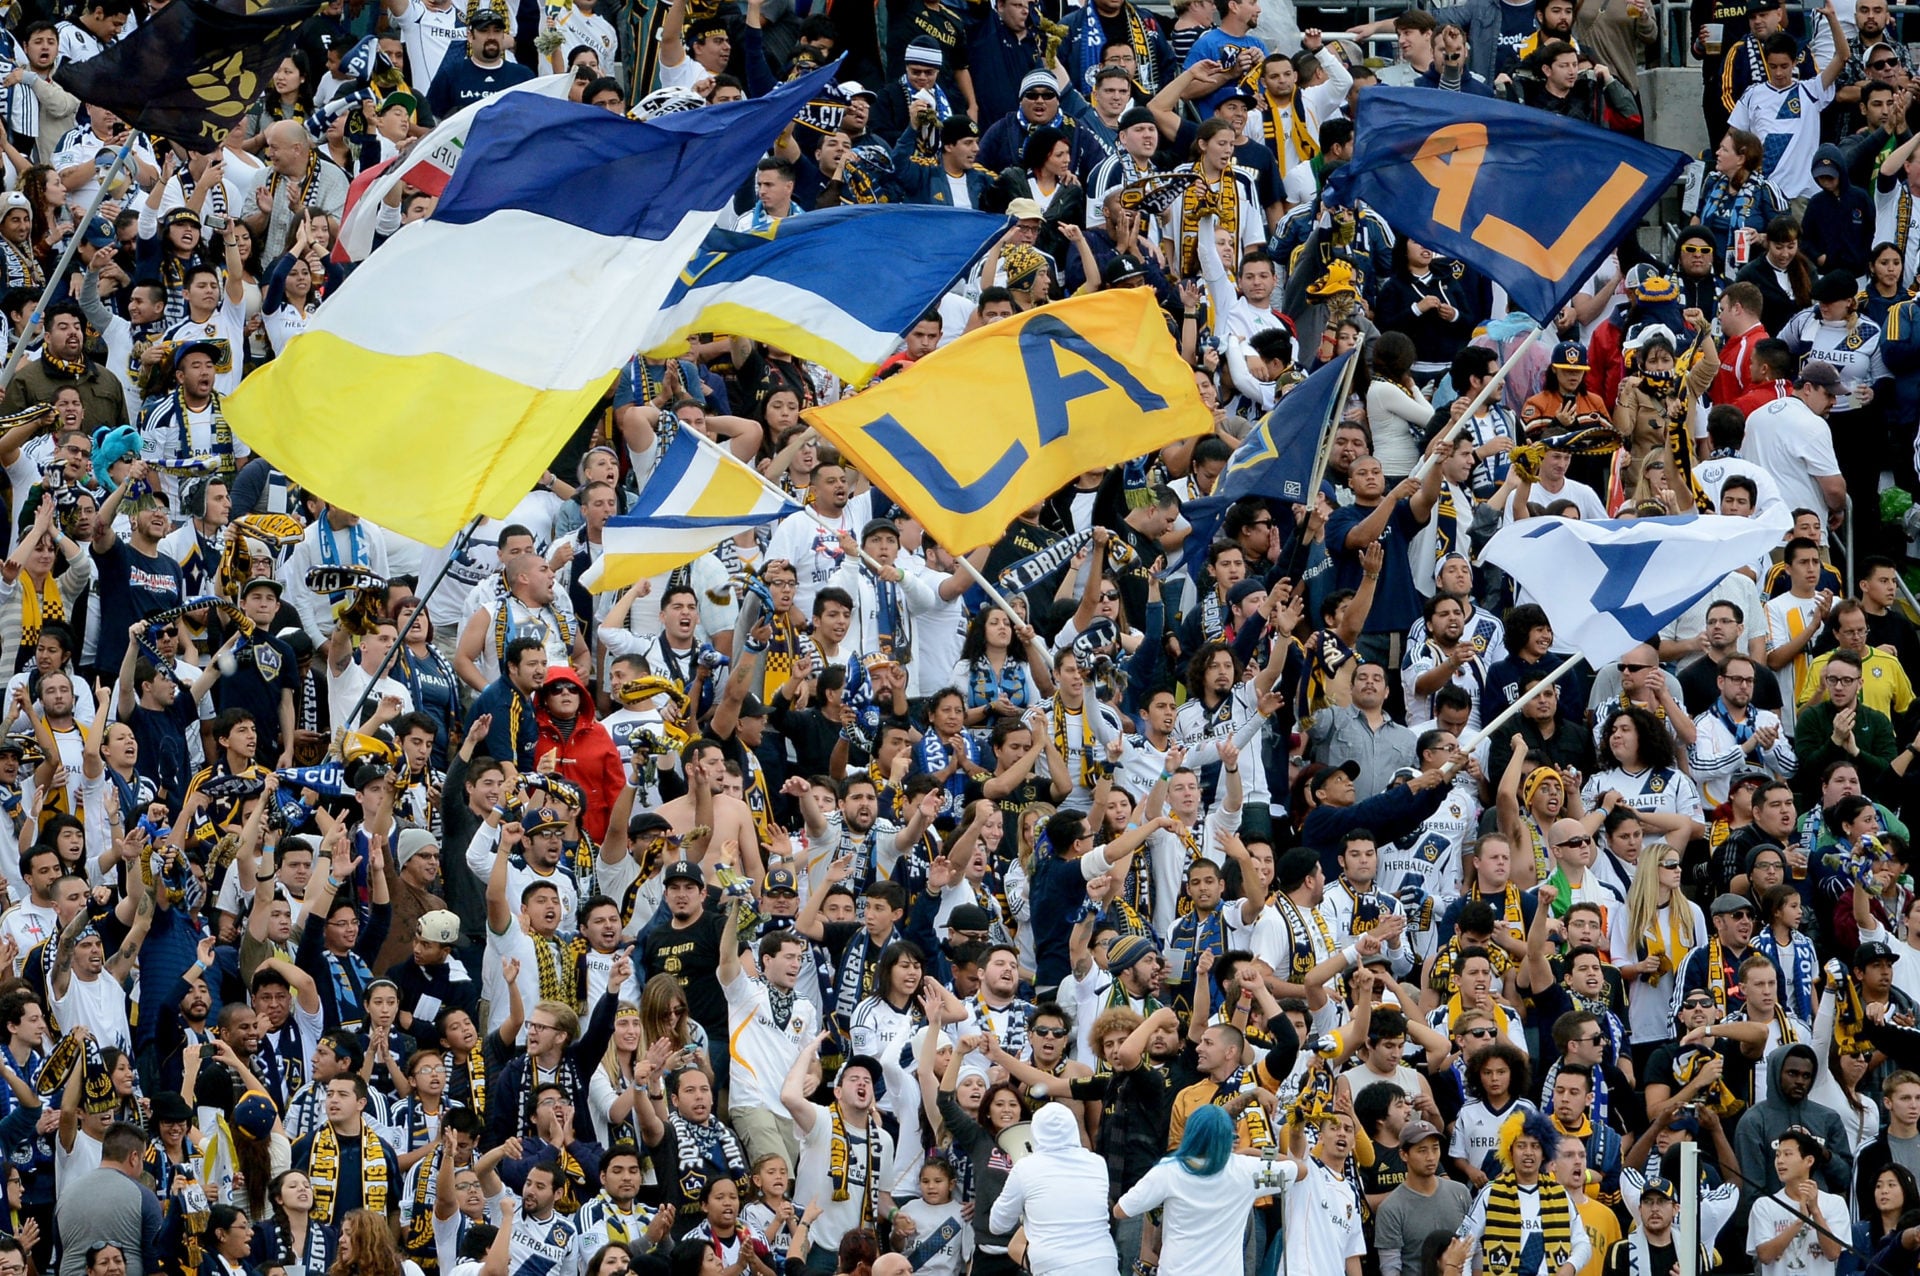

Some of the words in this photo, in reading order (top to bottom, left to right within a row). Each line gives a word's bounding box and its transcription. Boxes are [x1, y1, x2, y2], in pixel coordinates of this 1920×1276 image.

[820, 106, 845, 128] CIT
[859, 313, 1172, 515] LA
[311, 571, 342, 592] CIT
[262, 652, 277, 667] LA
[750, 797, 764, 811] LA
[686, 1181, 703, 1191] LA
[366, 1184, 387, 1212] HIS
[1491, 1254, 1508, 1267] LA
